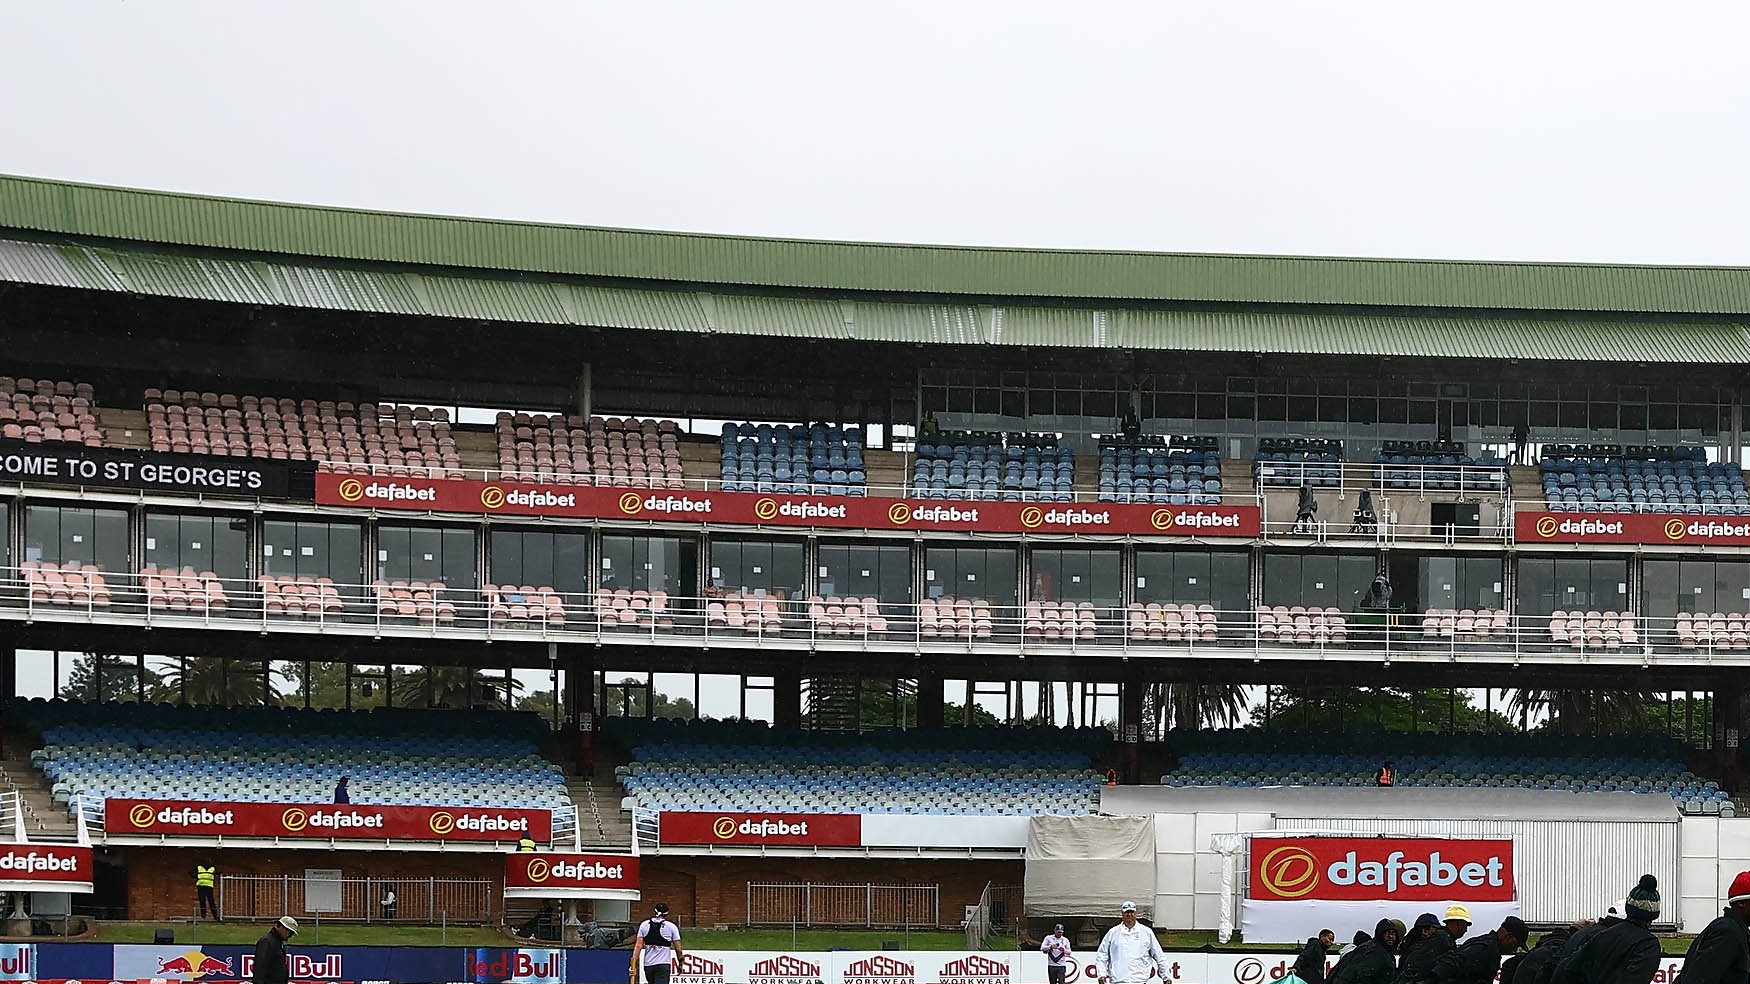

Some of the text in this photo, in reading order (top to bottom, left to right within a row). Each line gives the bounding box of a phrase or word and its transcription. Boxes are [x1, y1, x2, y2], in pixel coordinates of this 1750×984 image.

[0, 455, 262, 488] OME TO ST GEORGE'S
[365, 482, 435, 501] dafabet
[507, 490, 575, 507] dafabet
[644, 496, 711, 513] dafabet
[780, 501, 846, 518] dafabet
[913, 506, 978, 523] dafabet
[1044, 509, 1109, 526] dafabet
[1175, 511, 1239, 528] dafabet
[1560, 519, 1622, 536] dafabet
[1687, 521, 1750, 538] dafabet
[158, 807, 233, 826] dafabet
[309, 811, 383, 829] dafabet
[456, 814, 527, 832] dafabet
[739, 819, 807, 837] dafabet
[0, 852, 76, 873] dafabet
[552, 861, 622, 880] dafabet
[1328, 851, 1503, 892] dafabet
[0, 948, 29, 974] ull
[294, 954, 342, 978] Bull
[513, 953, 560, 977] Bull
[671, 954, 724, 975] NSSON
[749, 956, 820, 976] JONSSON
[843, 956, 914, 976] JONSSON
[939, 955, 1009, 976] JONSSON
